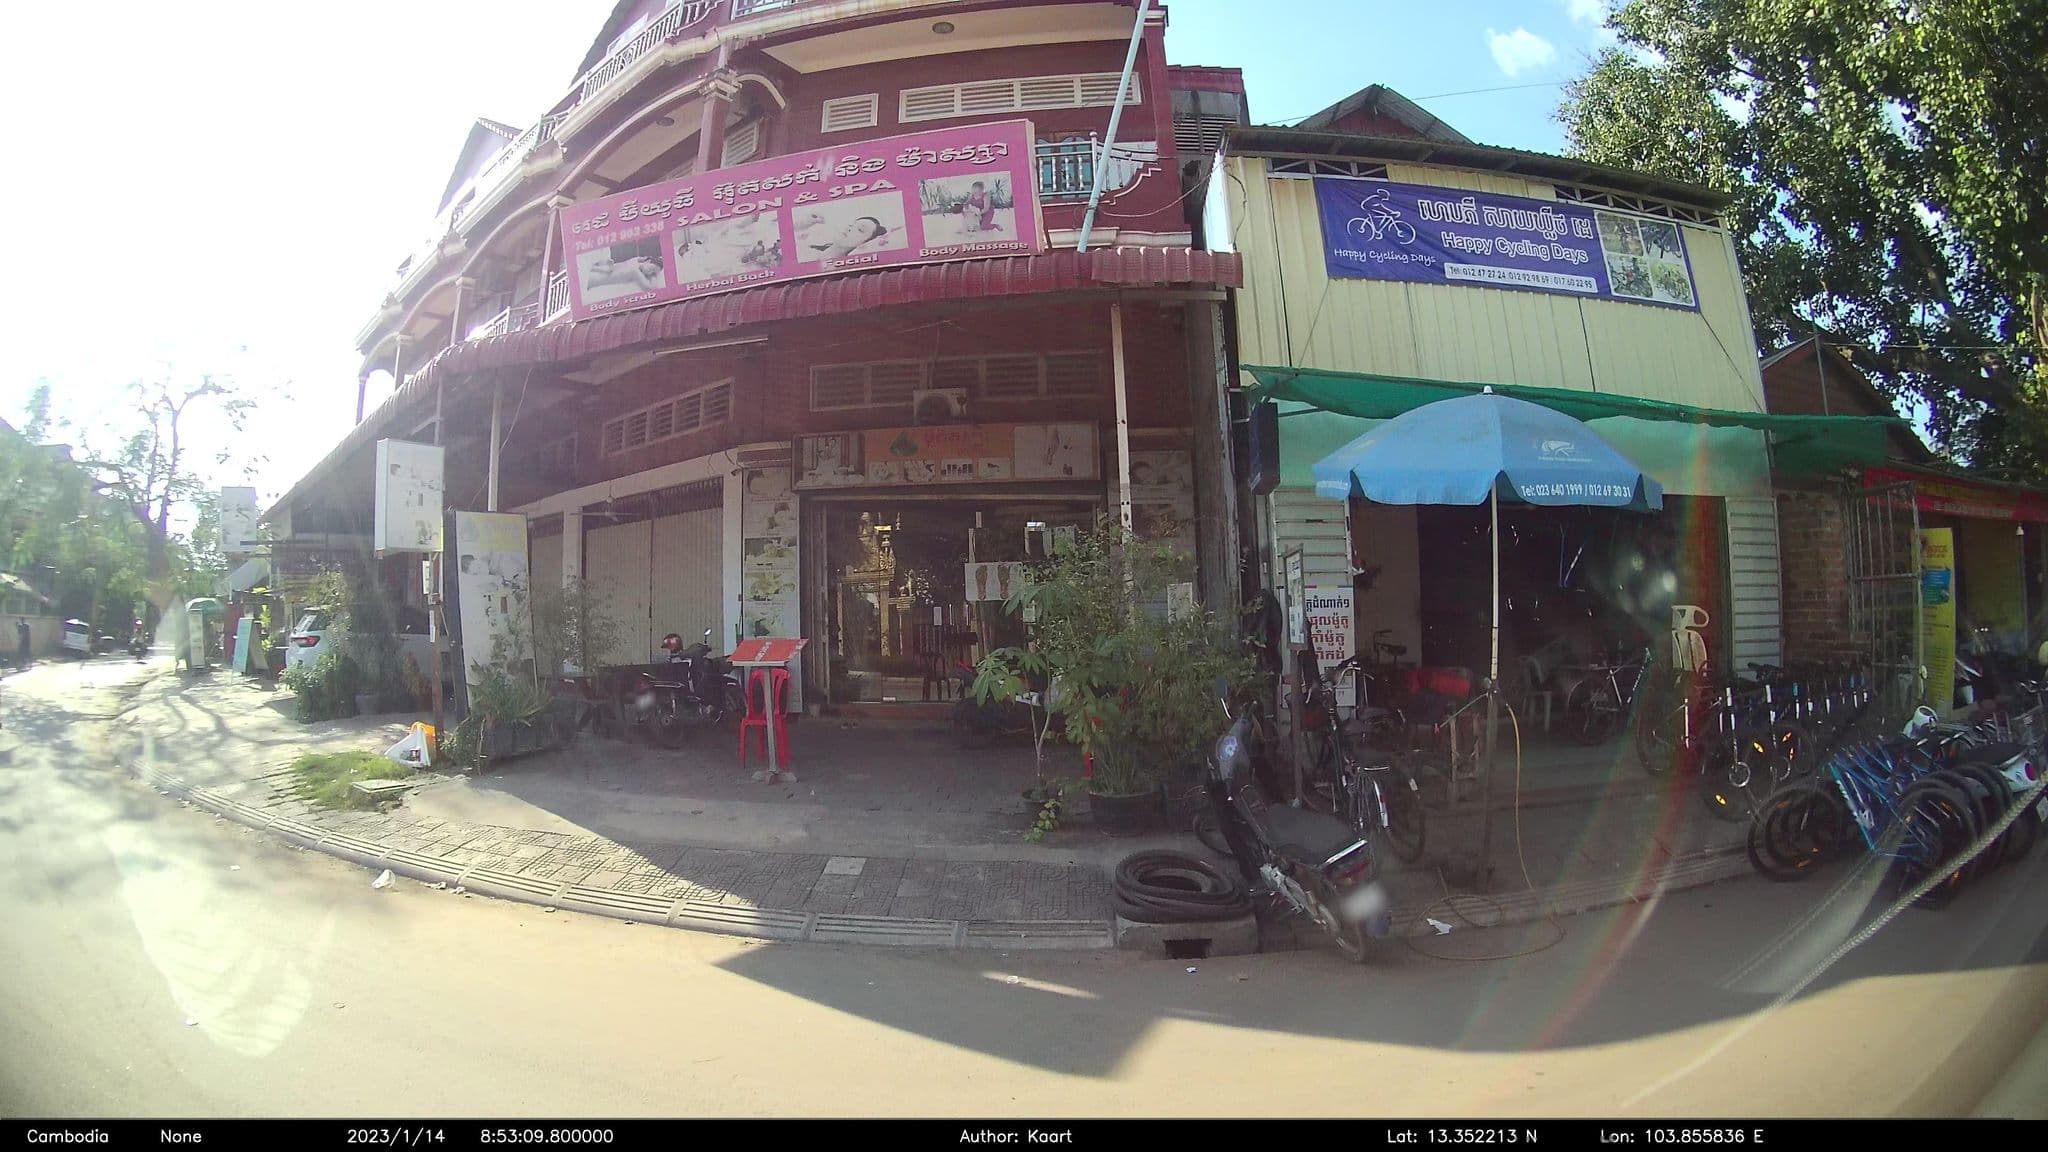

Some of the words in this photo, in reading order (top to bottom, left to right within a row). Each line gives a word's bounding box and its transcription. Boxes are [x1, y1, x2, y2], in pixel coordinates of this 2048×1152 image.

[676, 197, 783, 227] SALON
[793, 191, 818, 206] &
[828, 179, 896, 198] SPA
[919, 247, 958, 258] Body
[961, 240, 1029, 252] Massage
[1334, 248, 1367, 262] Happy
[1369, 250, 1409, 264] Cycling
[1441, 231, 1493, 256] Happy
[1495, 237, 1550, 261] Cycling
[1552, 244, 1589, 265] Days
[823, 254, 879, 269] Facial
[686, 274, 735, 292] Herbal
[590, 299, 619, 311] Body
[1520, 485, 1536, 497] Tel:
[1535, 484, 1550, 496] 023
